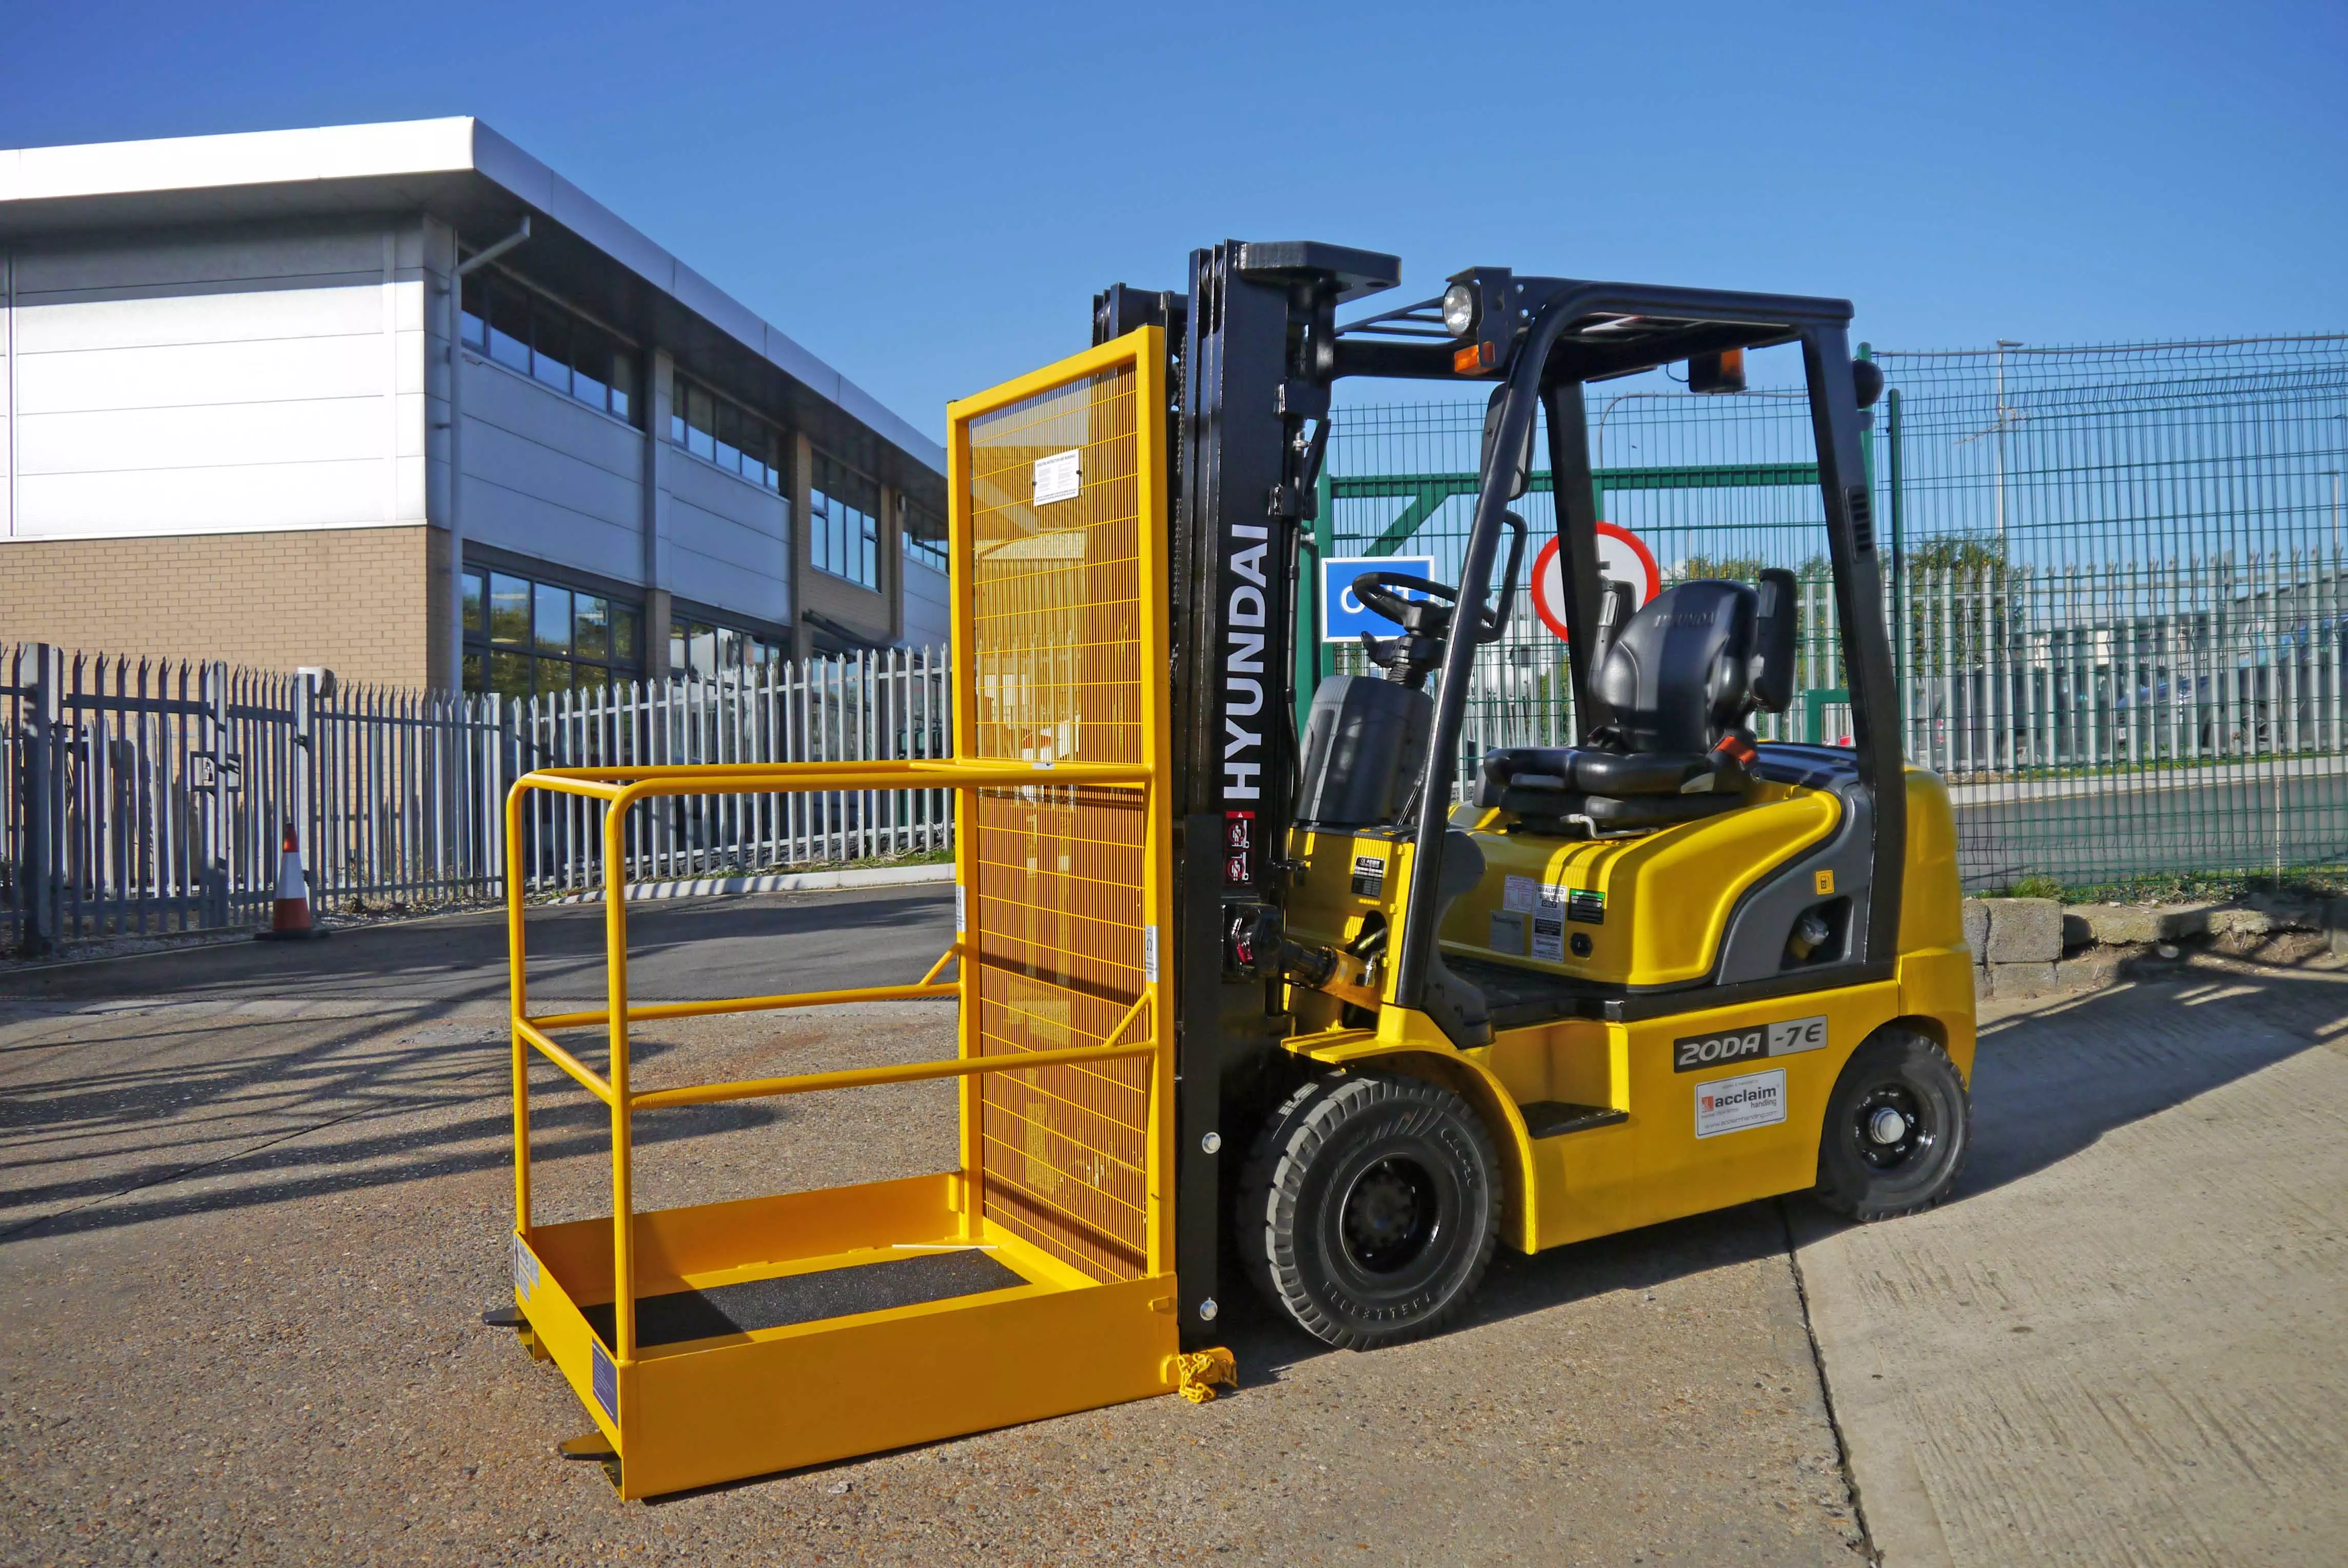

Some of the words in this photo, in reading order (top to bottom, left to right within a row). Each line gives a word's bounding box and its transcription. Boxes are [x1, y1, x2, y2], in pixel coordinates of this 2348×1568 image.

[1341, 584, 1415, 614] OT
[1223, 523, 1268, 799] HYUNDAI
[1715, 1087, 1776, 1107] acclaim
[1751, 1099, 1777, 1109] handling
